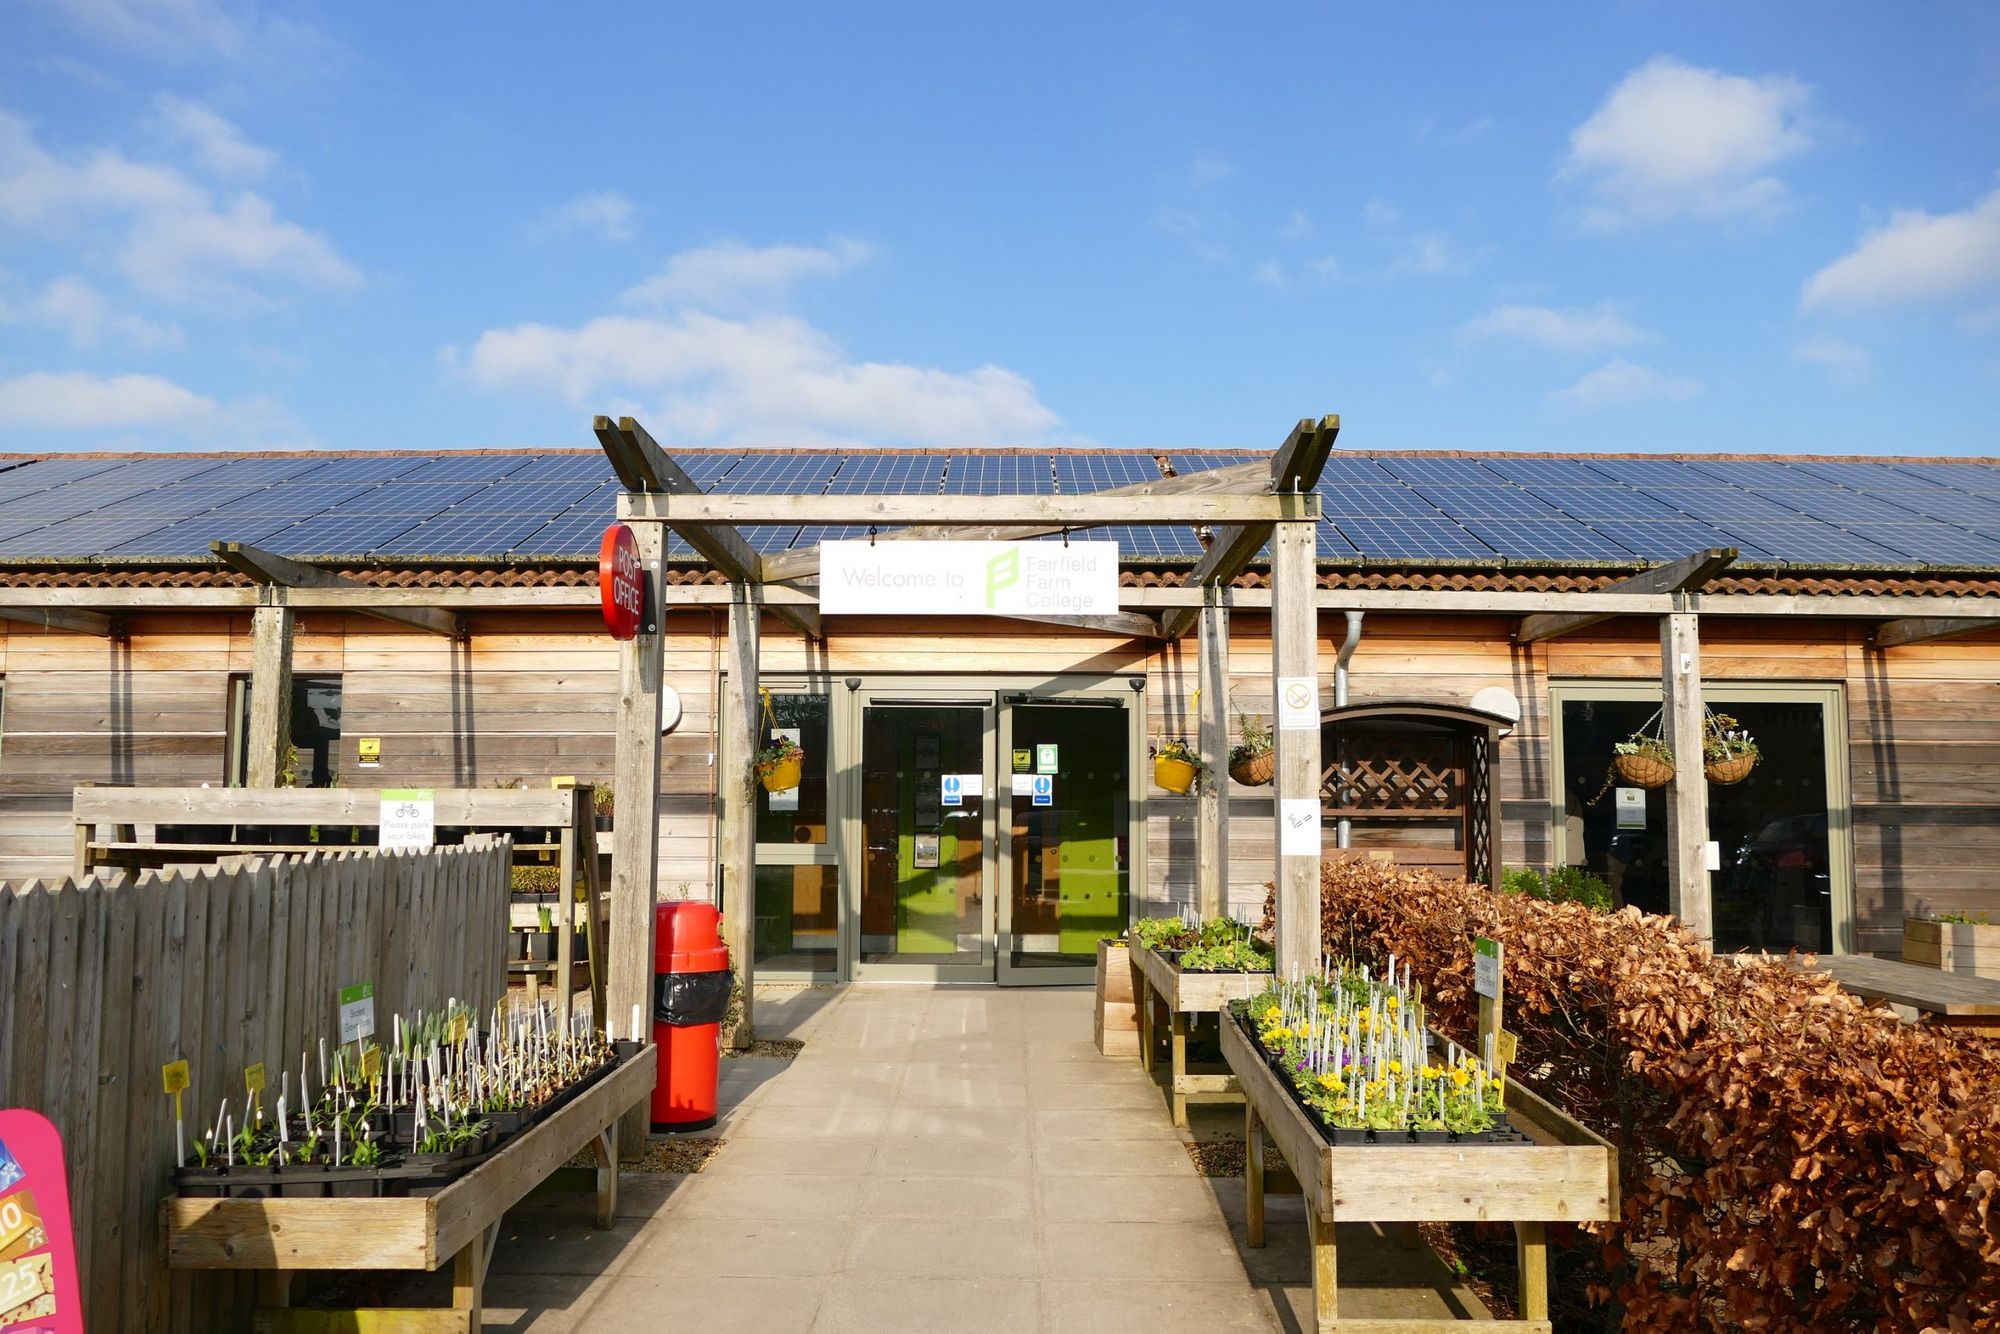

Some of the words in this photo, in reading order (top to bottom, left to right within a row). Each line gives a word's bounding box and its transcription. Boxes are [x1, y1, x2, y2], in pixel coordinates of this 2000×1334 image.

[618, 546, 639, 583] POST
[1026, 554, 1097, 573] Fairfield
[842, 565, 936, 588] Welcome
[945, 566, 964, 588] to
[1026, 574, 1071, 590] Farm
[613, 575, 640, 616] OFFICE
[1026, 591, 1094, 609] College
[384, 820, 410, 829] Please
[410, 820, 429, 831] park
[407, 831, 426, 841] bikes
[3, 1262, 38, 1298] 25
